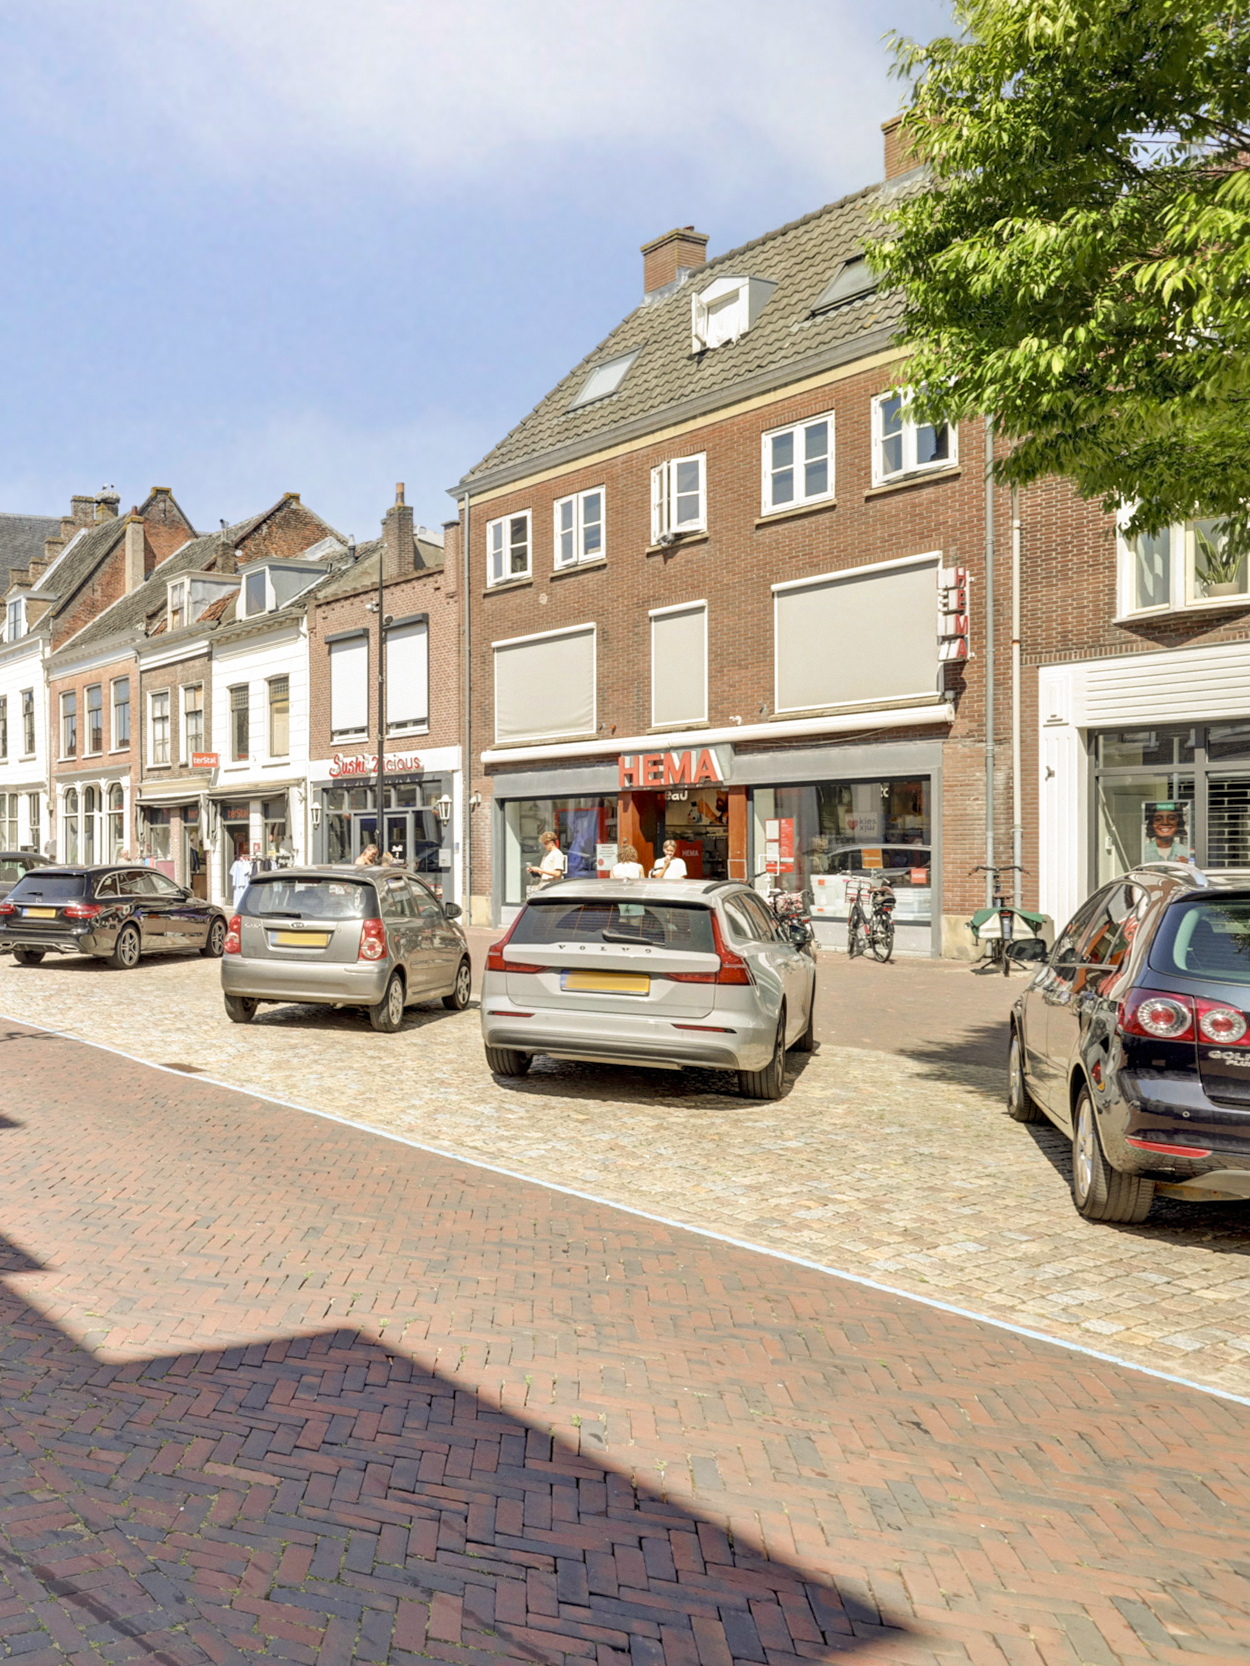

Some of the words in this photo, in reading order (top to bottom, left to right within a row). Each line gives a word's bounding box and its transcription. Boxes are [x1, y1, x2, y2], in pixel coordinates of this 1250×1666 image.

[193, 756, 217, 765] terStal
[329, 754, 367, 778] Sushi
[371, 753, 422, 774] 2icious
[618, 748, 720, 789] HEMA
[859, 817, 877, 825] kies
[558, 944, 652, 954] VOLVO
